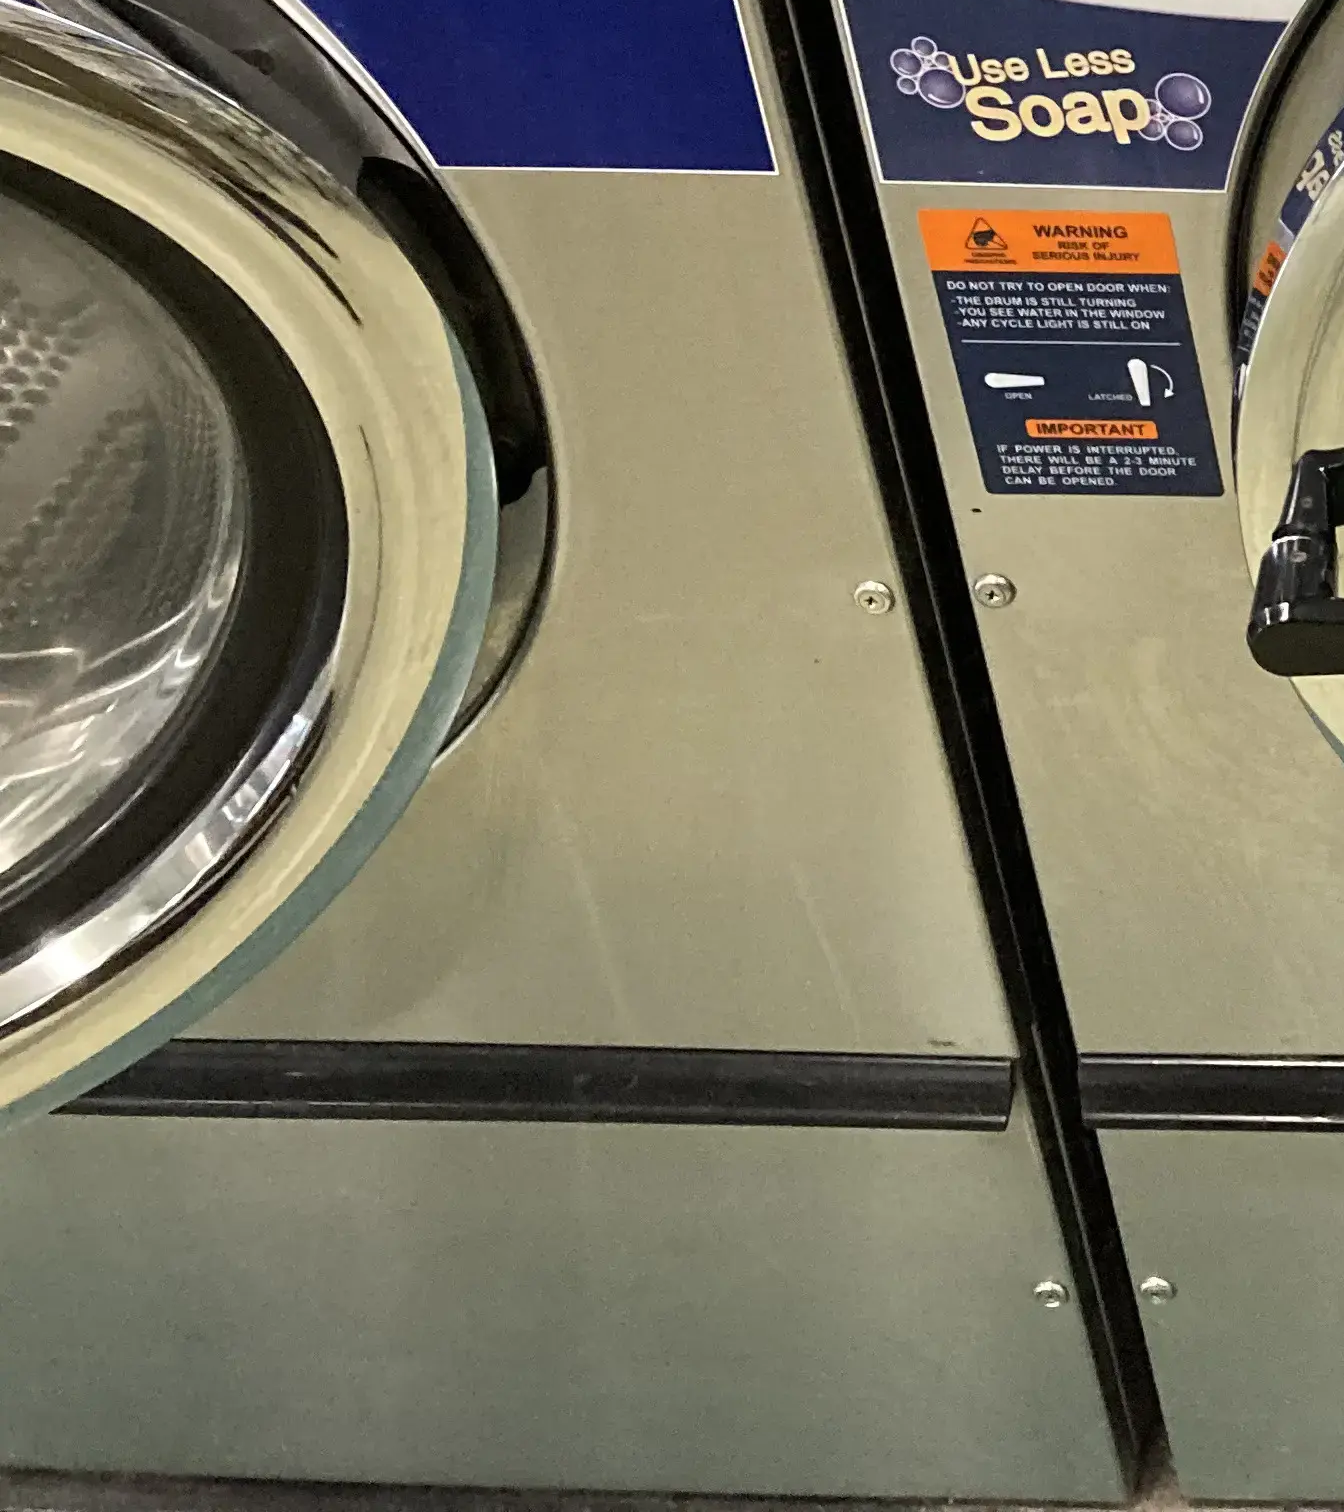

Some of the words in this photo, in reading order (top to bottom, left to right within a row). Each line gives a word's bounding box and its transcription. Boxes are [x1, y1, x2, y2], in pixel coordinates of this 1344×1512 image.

[949, 54, 1029, 86] Use
[1036, 48, 1136, 80] Less
[965, 86, 1151, 144] Soap
[1033, 225, 1128, 239] WARNING
[1057, 241, 1087, 250] RISK
[1092, 242, 1109, 250] OF
[947, 281, 966, 290] DO
[969, 281, 995, 290] NOT
[999, 281, 1023, 291] TRY
[1028, 282, 1044, 291] TO
[1048, 282, 1083, 292] OPEN
[1086, 283, 1124, 292] DOOR
[1036, 423, 1146, 436] IMPORTANT
